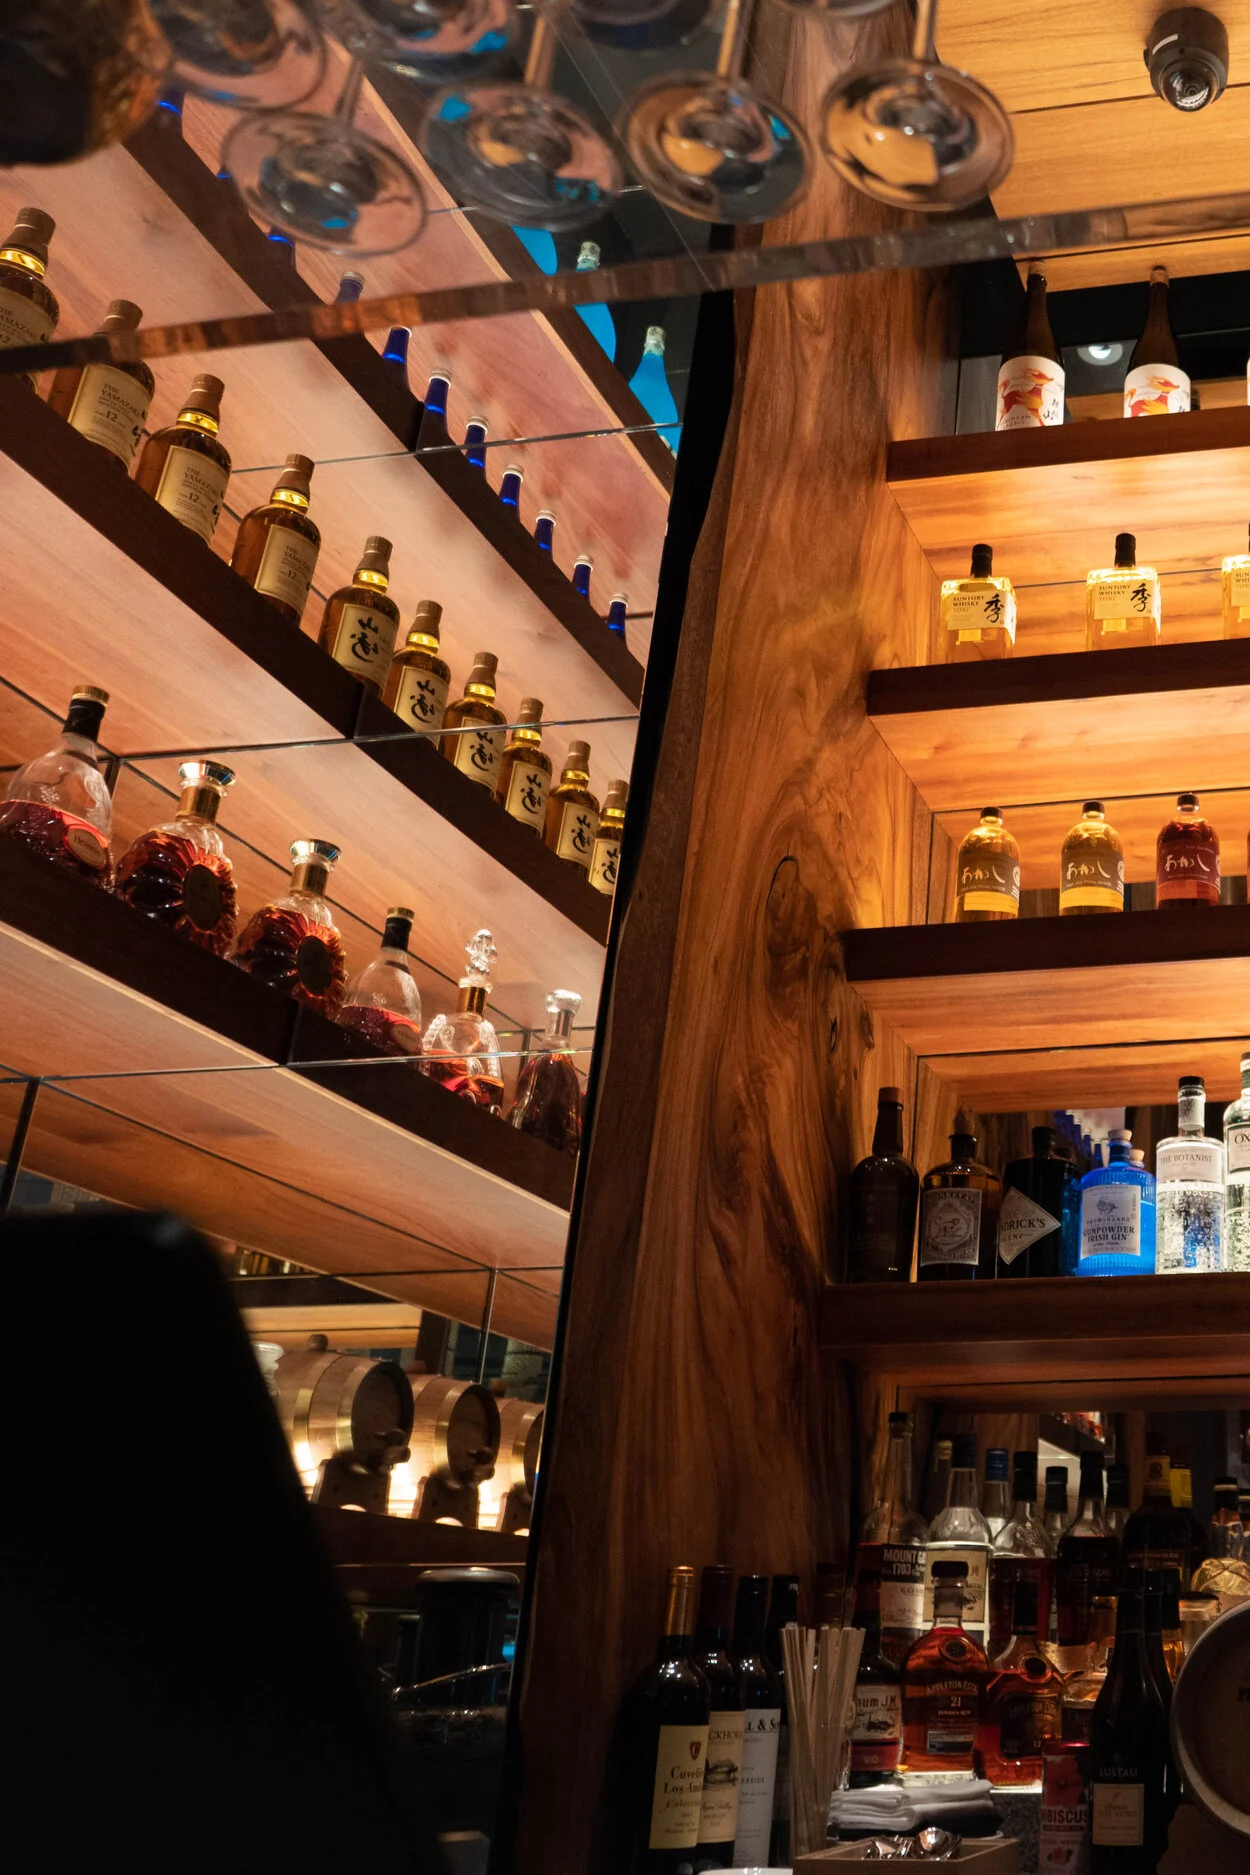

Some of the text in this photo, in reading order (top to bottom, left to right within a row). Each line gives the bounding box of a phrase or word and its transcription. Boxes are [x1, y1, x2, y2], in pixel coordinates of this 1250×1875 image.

[104, 384, 120, 394] THE
[106, 411, 118, 423] 12
[189, 493, 200, 503] 12
[288, 570, 298, 581] 12
[1130, 582, 1151, 612] 季
[984, 593, 1005, 623] 季
[1174, 1153, 1213, 1163] BOTANIST
[999, 1217, 1045, 1231] DRICK'S
[1082, 1226, 1135, 1236] GUNPOWDER
[1087, 1232, 1128, 1243] IRISH GIN
[883, 1549, 917, 1563] MOUNT
[892, 1564, 912, 1576] 1703
[926, 1682, 962, 1697] APPLETON
[949, 1697, 962, 1707] 21
[757, 1719, 767, 1732] &
[1100, 1767, 1140, 1778] LUSTAU
[1047, 1808, 1089, 1824] BISCUS
